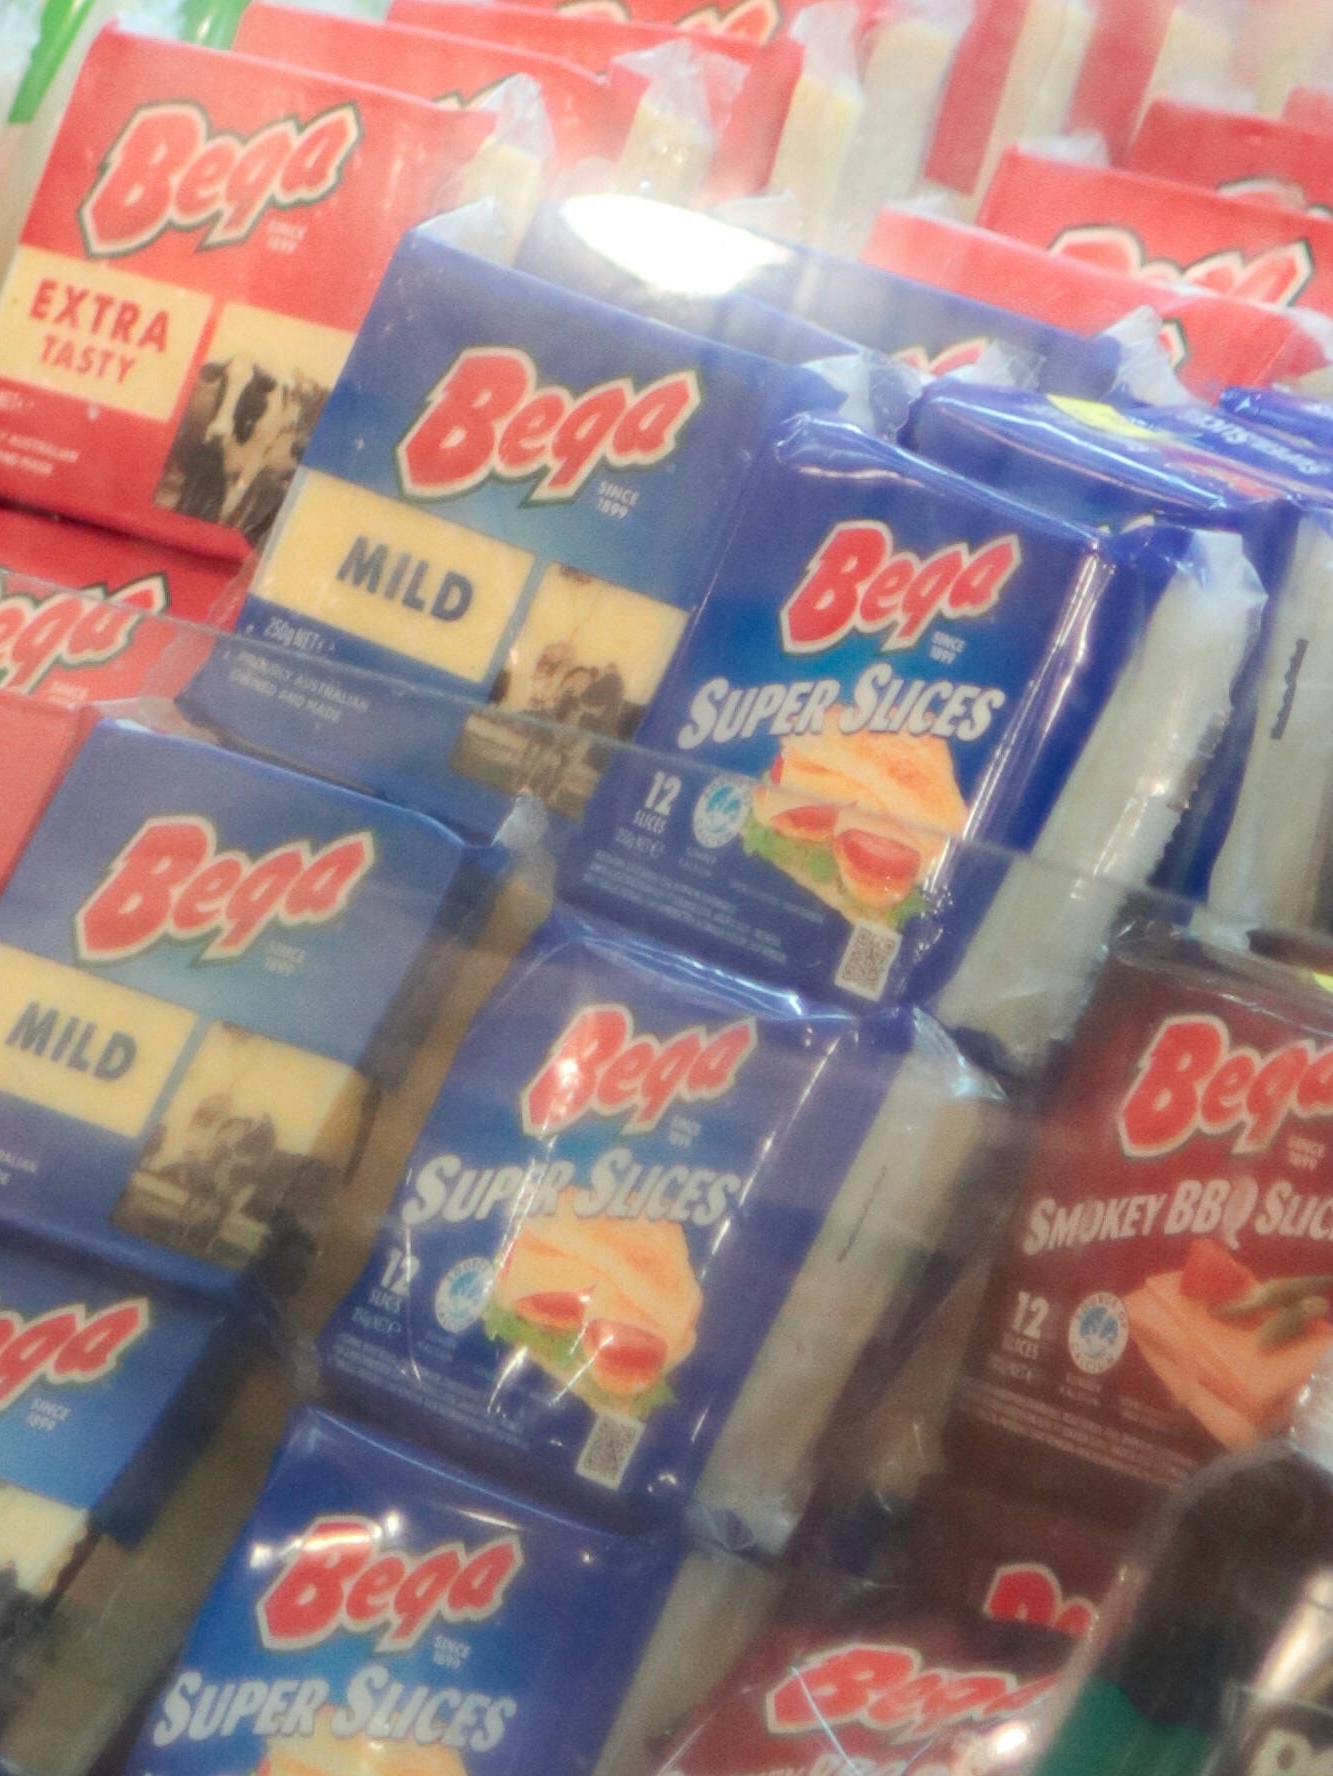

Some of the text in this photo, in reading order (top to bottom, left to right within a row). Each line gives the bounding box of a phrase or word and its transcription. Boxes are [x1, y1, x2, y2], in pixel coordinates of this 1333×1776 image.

[78, 101, 361, 257] Bega
[29, 279, 170, 353] EXTRA
[41, 334, 137, 384] TASTY
[396, 345, 701, 507] Bega
[597, 479, 640, 508] SINCE
[337, 534, 474, 622] MILD
[781, 519, 1021, 654] Bega
[678, 662, 1007, 750] SUPER SLICES
[643, 770, 682, 816] 12
[73, 815, 375, 968] Bega
[4, 1000, 137, 1082] MILD
[521, 1003, 758, 1138] Bega
[401, 1148, 742, 1226] SUPER SLICES
[1022, 1174, 1333, 1256] SMOKEY BBQ SLIC
[380, 1249, 422, 1297] 12
[1012, 1290, 1049, 1339] 12
[257, 1513, 523, 1653] Bega
[151, 1664, 519, 1752] SUPER SLICES
